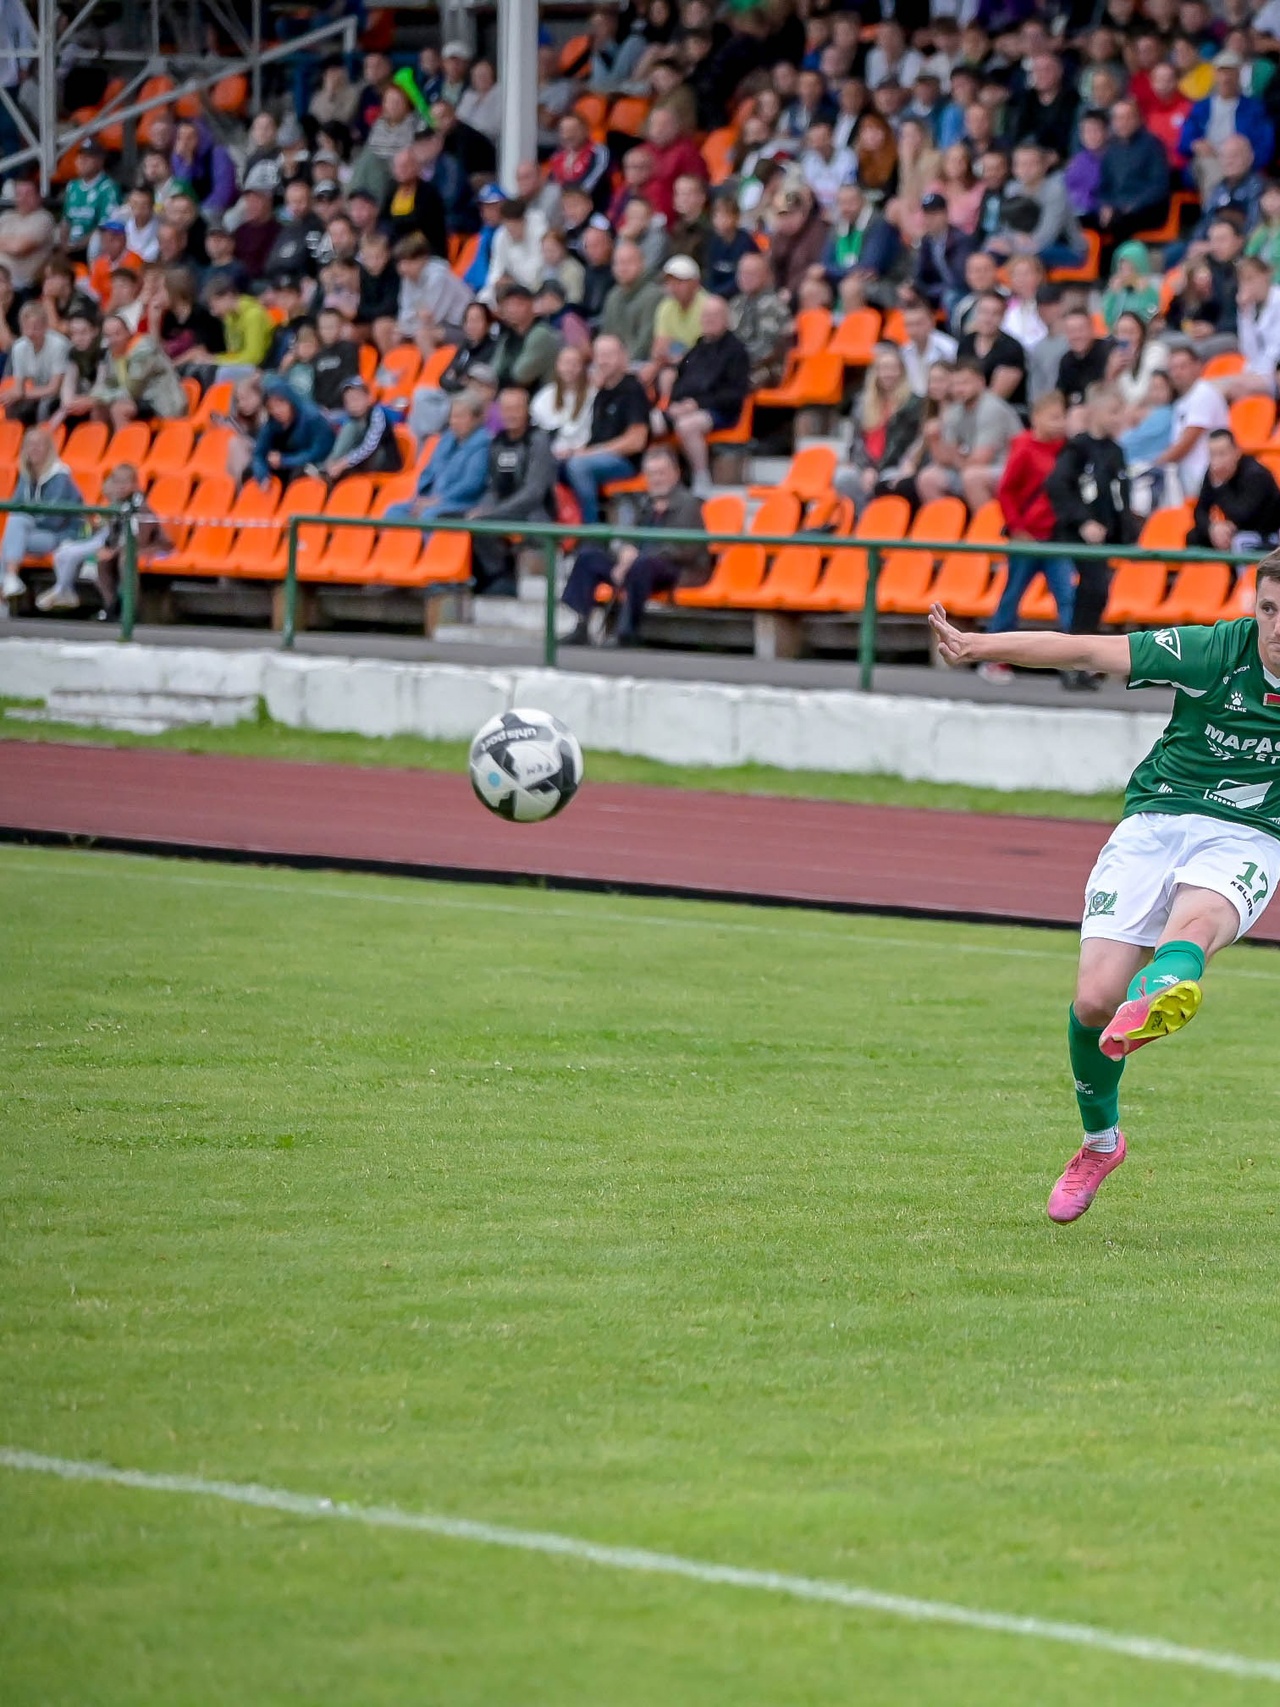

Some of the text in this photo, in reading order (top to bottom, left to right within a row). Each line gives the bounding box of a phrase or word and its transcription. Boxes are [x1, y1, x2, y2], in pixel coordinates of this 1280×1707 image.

[1224, 703, 1247, 713] KELME
[480, 727, 537, 752] uhlsport
[1235, 861, 1268, 904] 17
